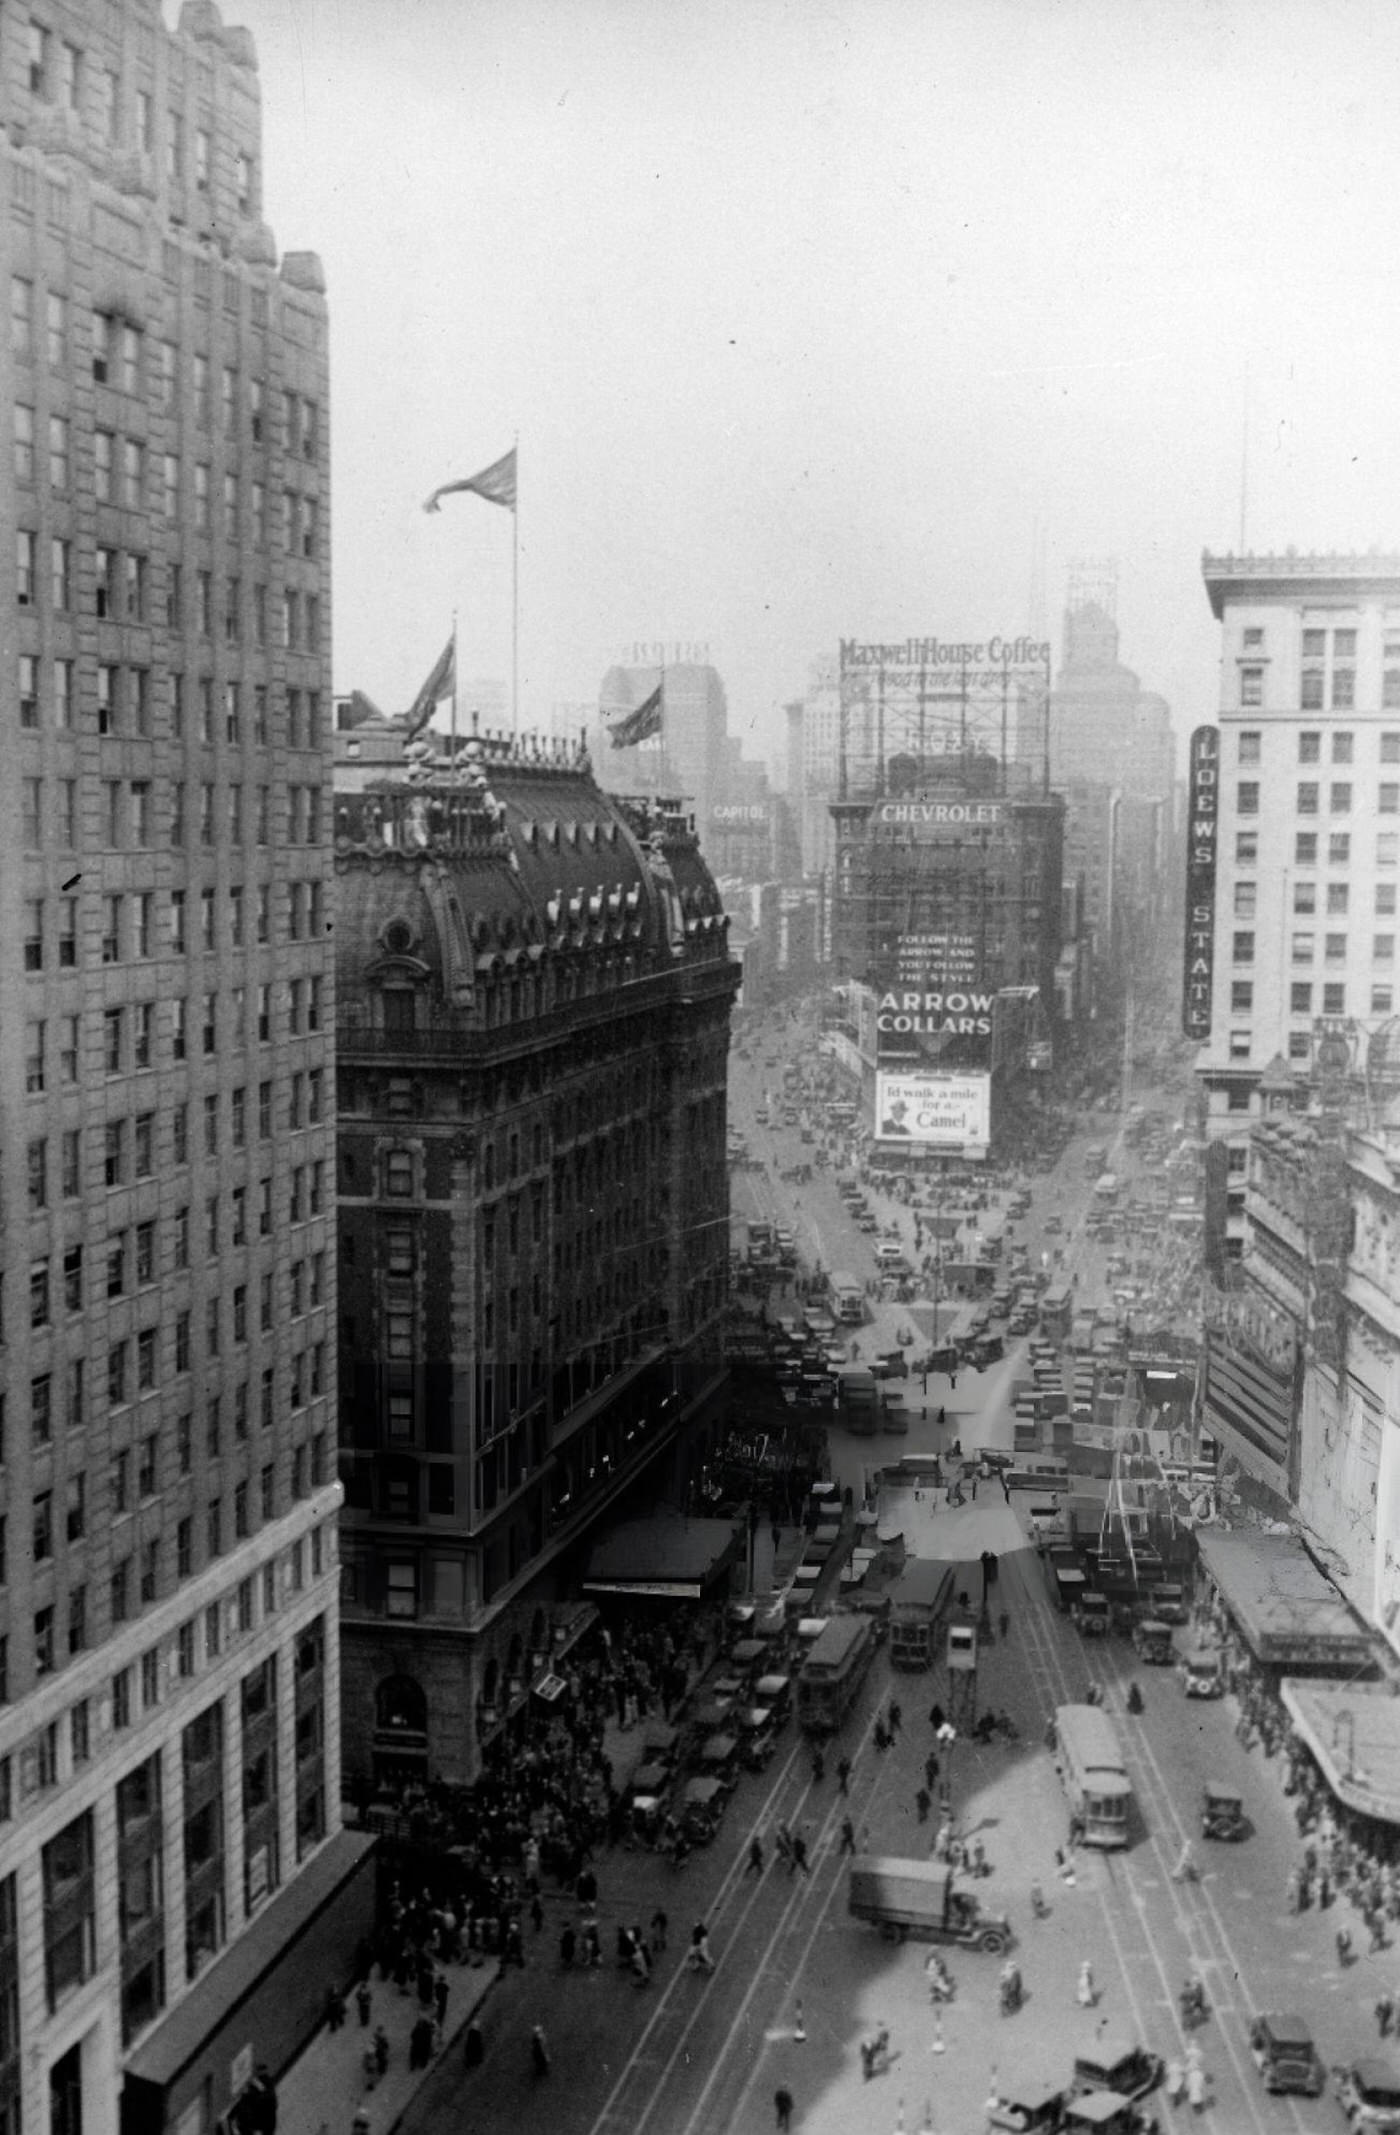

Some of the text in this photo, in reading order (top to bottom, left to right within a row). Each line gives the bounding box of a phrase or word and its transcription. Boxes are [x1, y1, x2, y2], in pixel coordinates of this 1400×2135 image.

[839, 635, 1050, 666] Maxwell House Coffee
[713, 805, 768, 820] CAPITOL
[881, 804, 1001, 823] CHEVROLET
[897, 935, 974, 945] FOLLOW THE
[898, 947, 976, 958] ARROW AND
[898, 960, 975, 971] YOU FOLLOW
[1191, 905, 1211, 1026] STATE
[898, 972, 975, 983] THE STYLE
[879, 992, 994, 1012] ARROW
[876, 1015, 992, 1035] COLLARS
[903, 1087, 934, 1098] walk
[938, 1090, 948, 1099] a
[949, 1088, 978, 1100] mile
[922, 1100, 941, 1111] for
[916, 1111, 967, 1129] Camel
